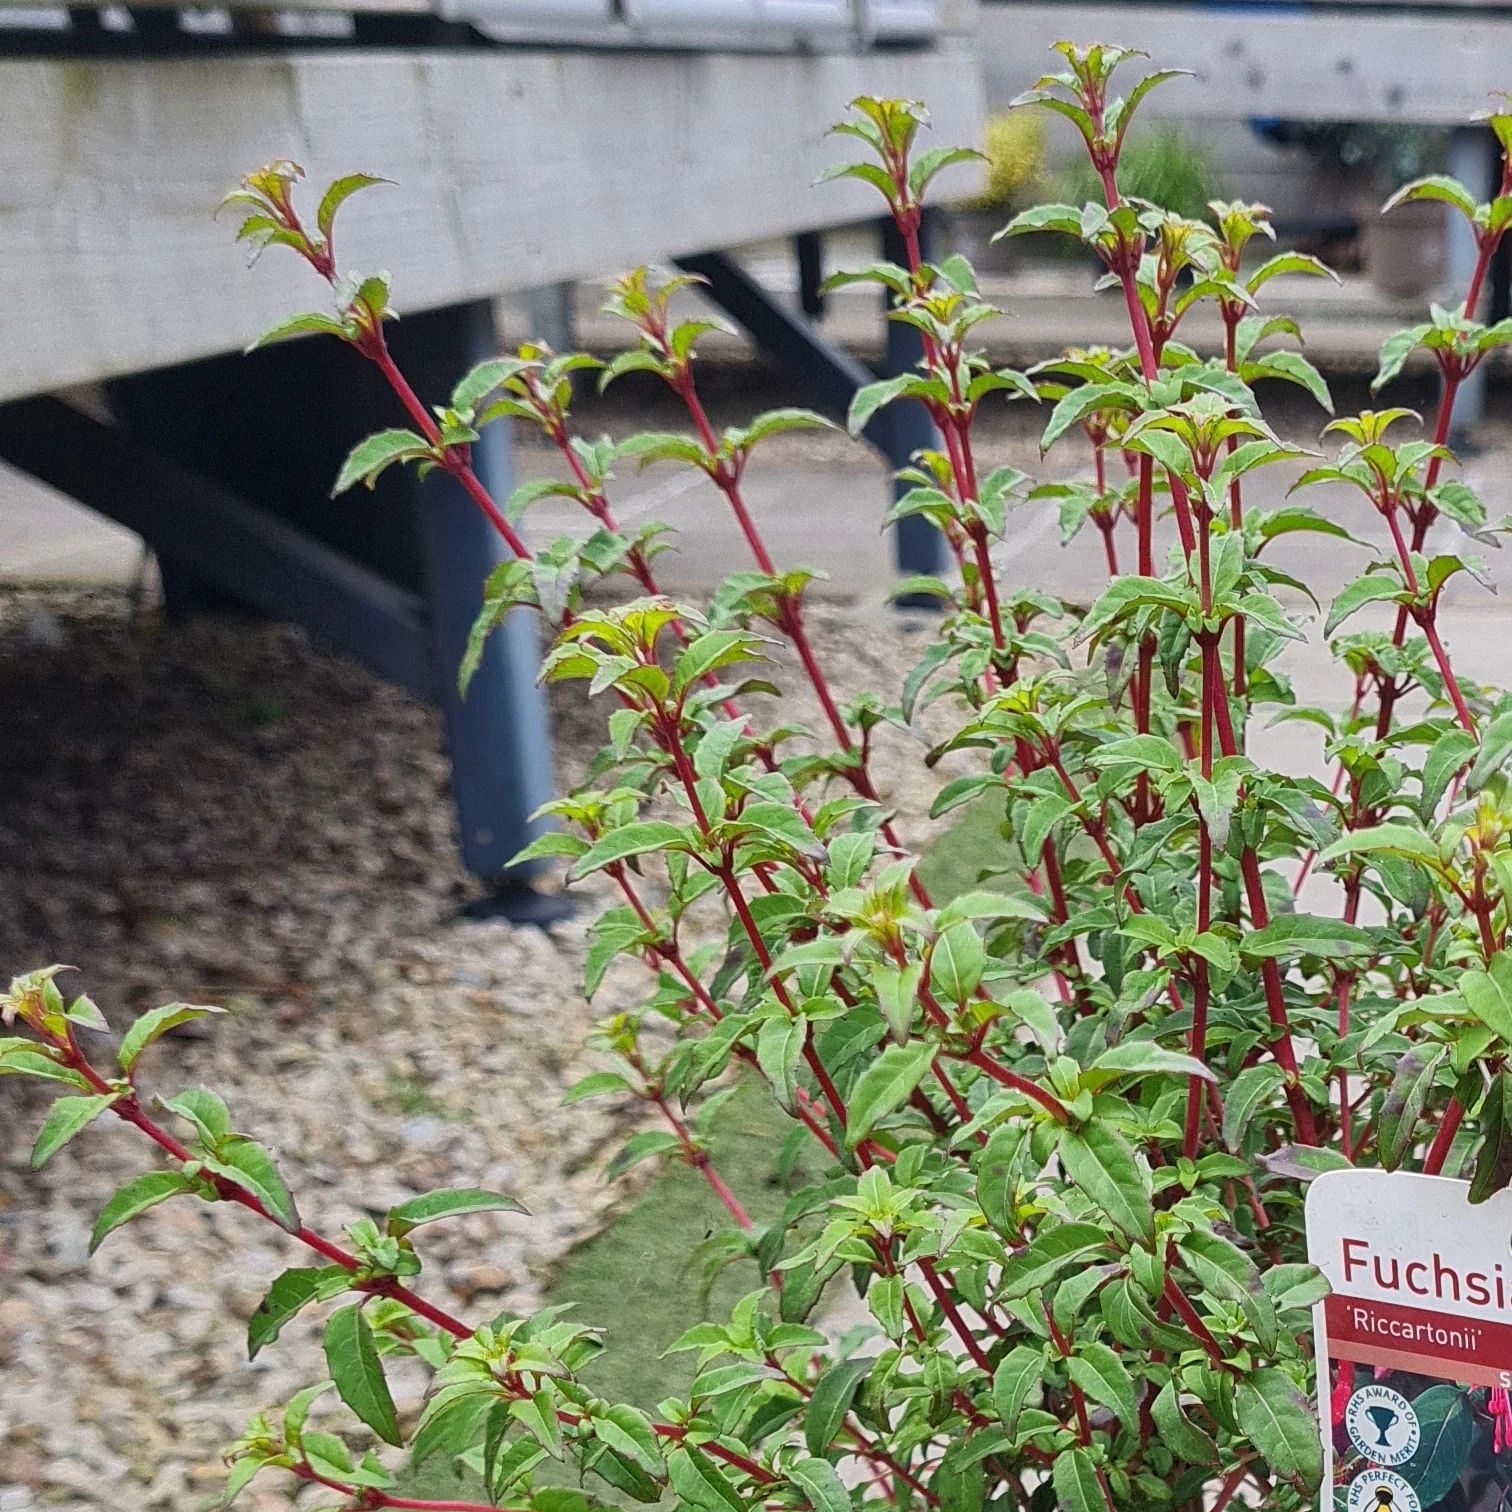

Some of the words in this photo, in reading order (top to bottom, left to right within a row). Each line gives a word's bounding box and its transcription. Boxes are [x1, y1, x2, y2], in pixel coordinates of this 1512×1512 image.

[1349, 1395, 1365, 1417] RHS
[1365, 1387, 1407, 1411] AWARD
[1405, 1411, 1417, 1429] OF
[1349, 1425, 1386, 1464] GARDEN
[1389, 1434, 1418, 1465] MERIT
[1350, 1482, 1363, 1506] RHS
[1362, 1470, 1409, 1495] PERFECT
